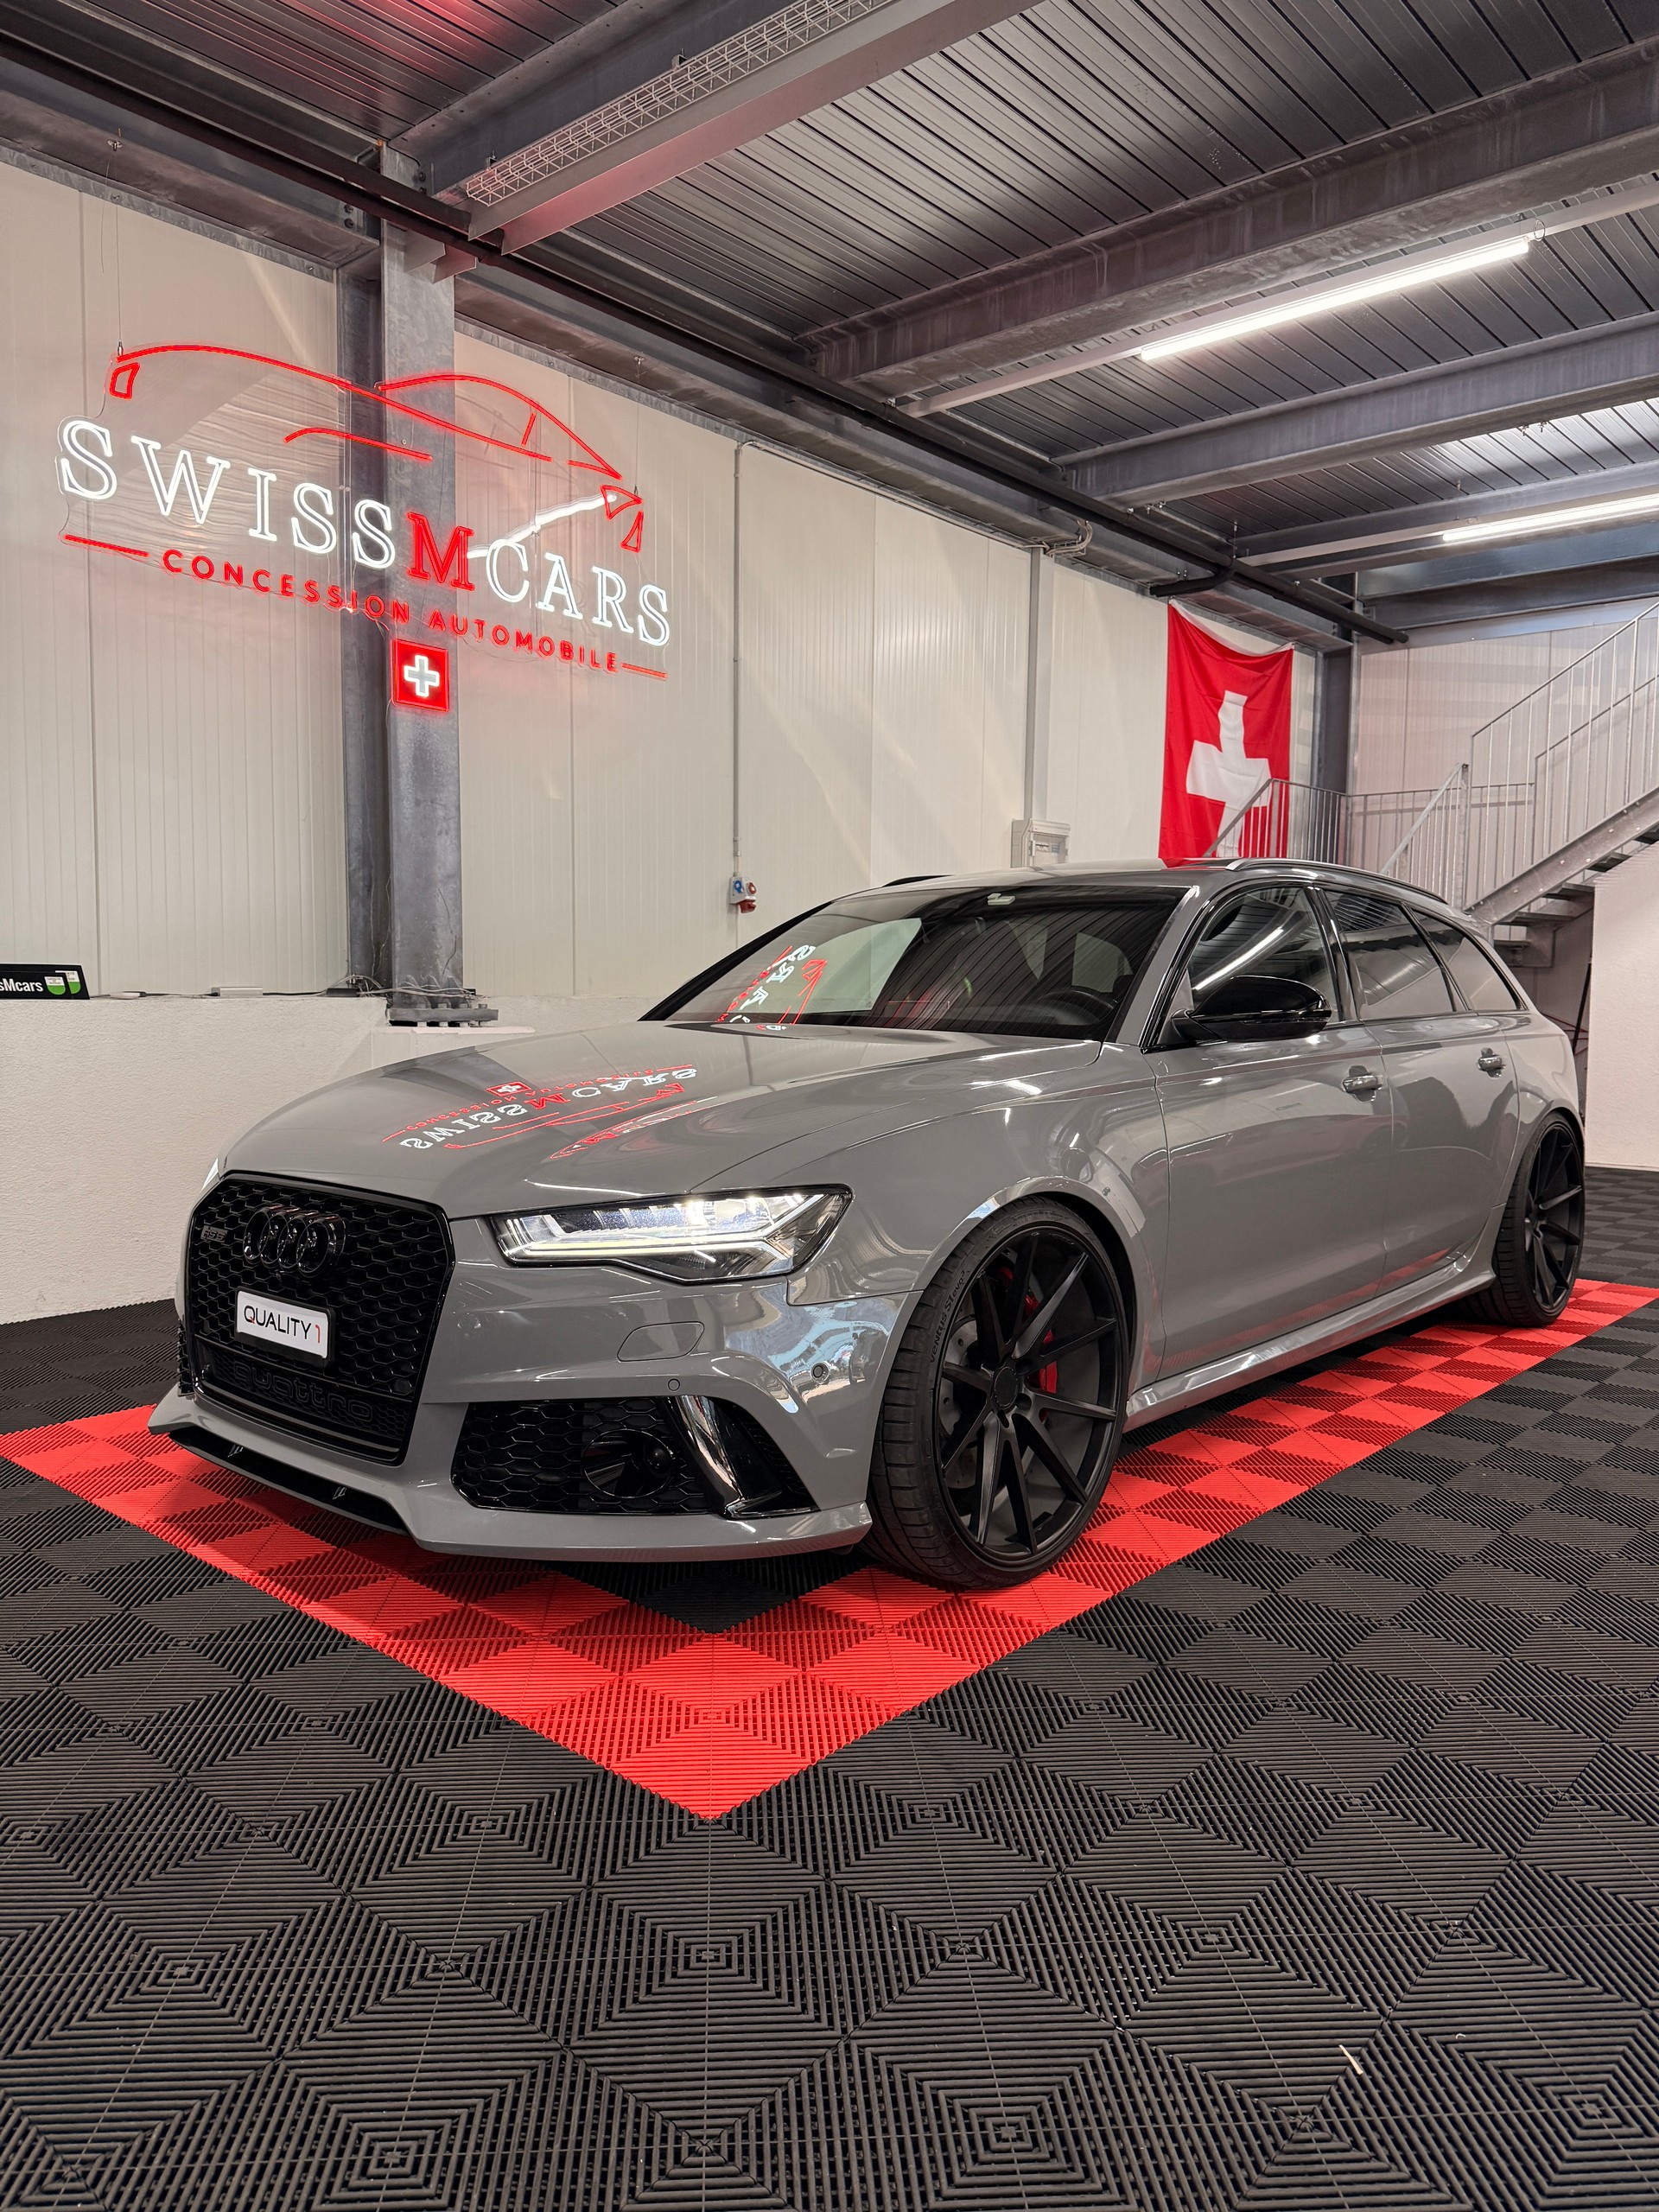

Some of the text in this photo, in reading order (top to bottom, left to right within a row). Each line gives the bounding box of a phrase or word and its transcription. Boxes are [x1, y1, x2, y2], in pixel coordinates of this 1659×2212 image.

[162, 549, 618, 672] CONCESSION AUTOMOBILE
[233, 1361, 373, 1422] quattro
